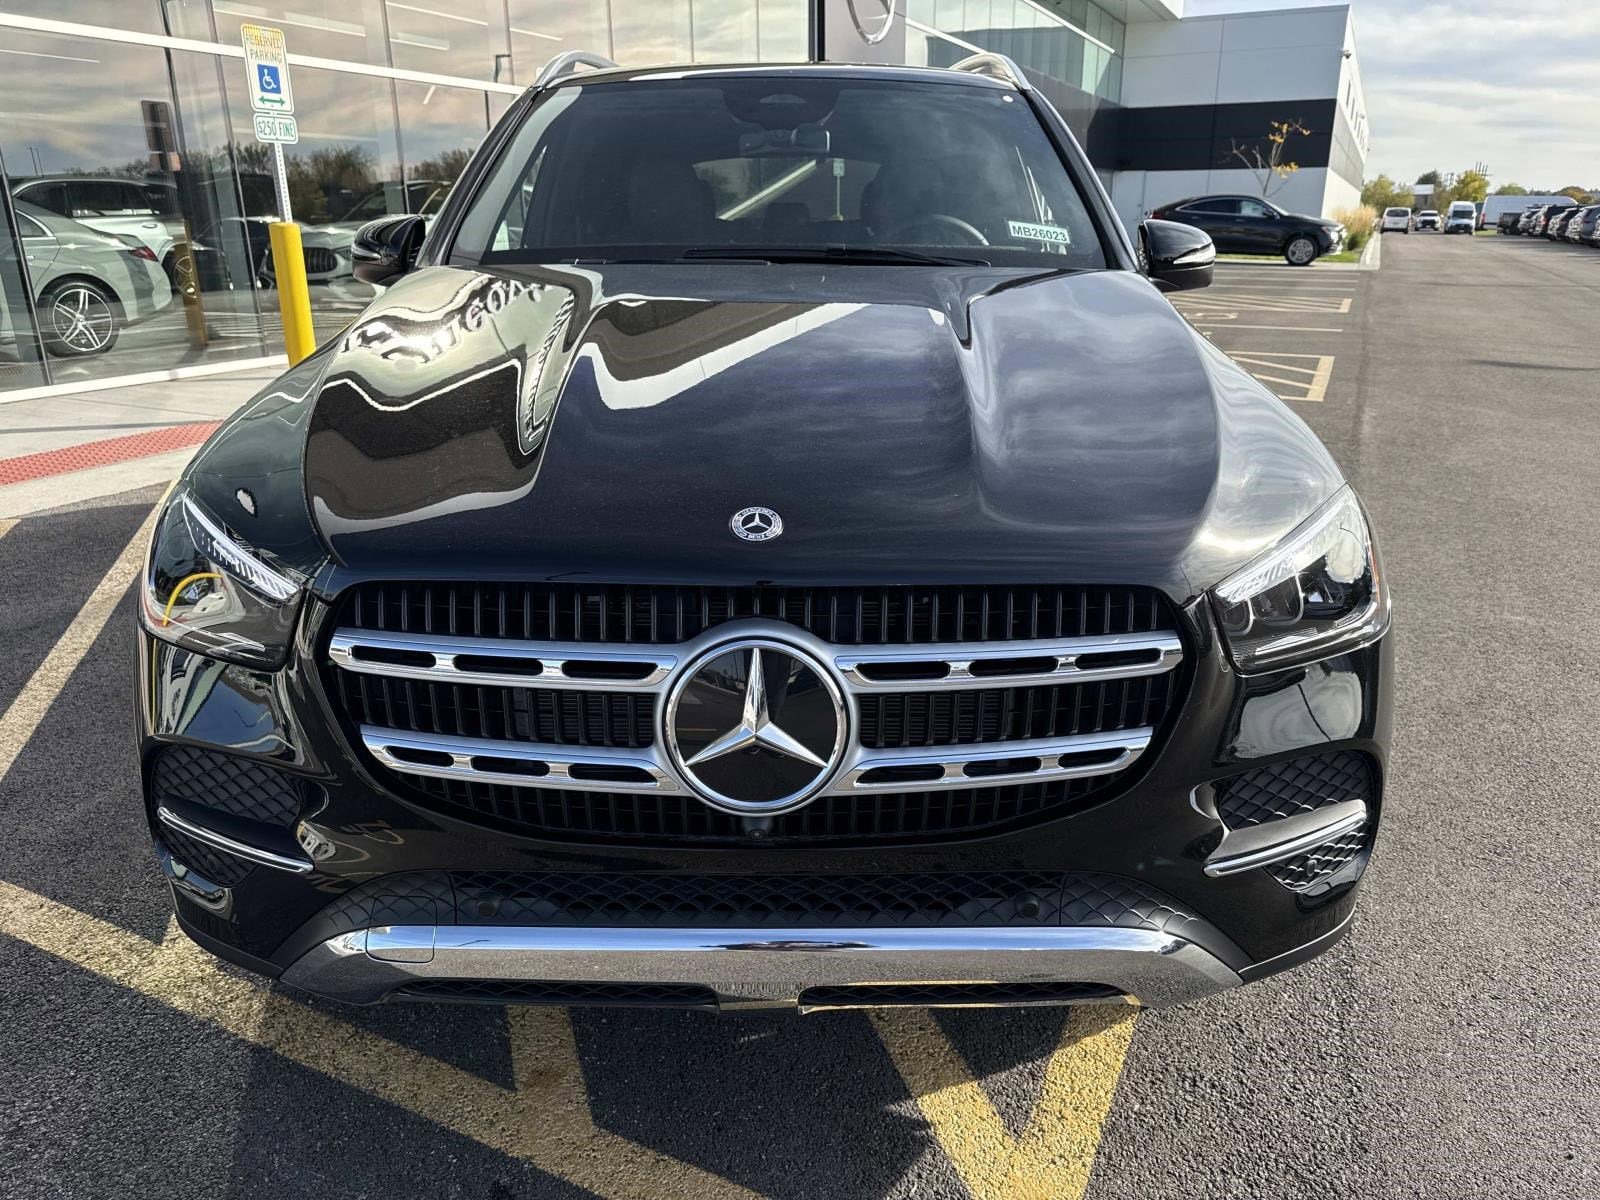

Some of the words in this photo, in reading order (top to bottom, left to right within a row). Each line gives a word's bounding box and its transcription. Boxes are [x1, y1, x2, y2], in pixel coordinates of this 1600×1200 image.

[250, 49, 282, 64] PARKING
[257, 120, 277, 137] $250
[278, 121, 294, 138] FINE
[1012, 225, 1067, 242] MB26023
